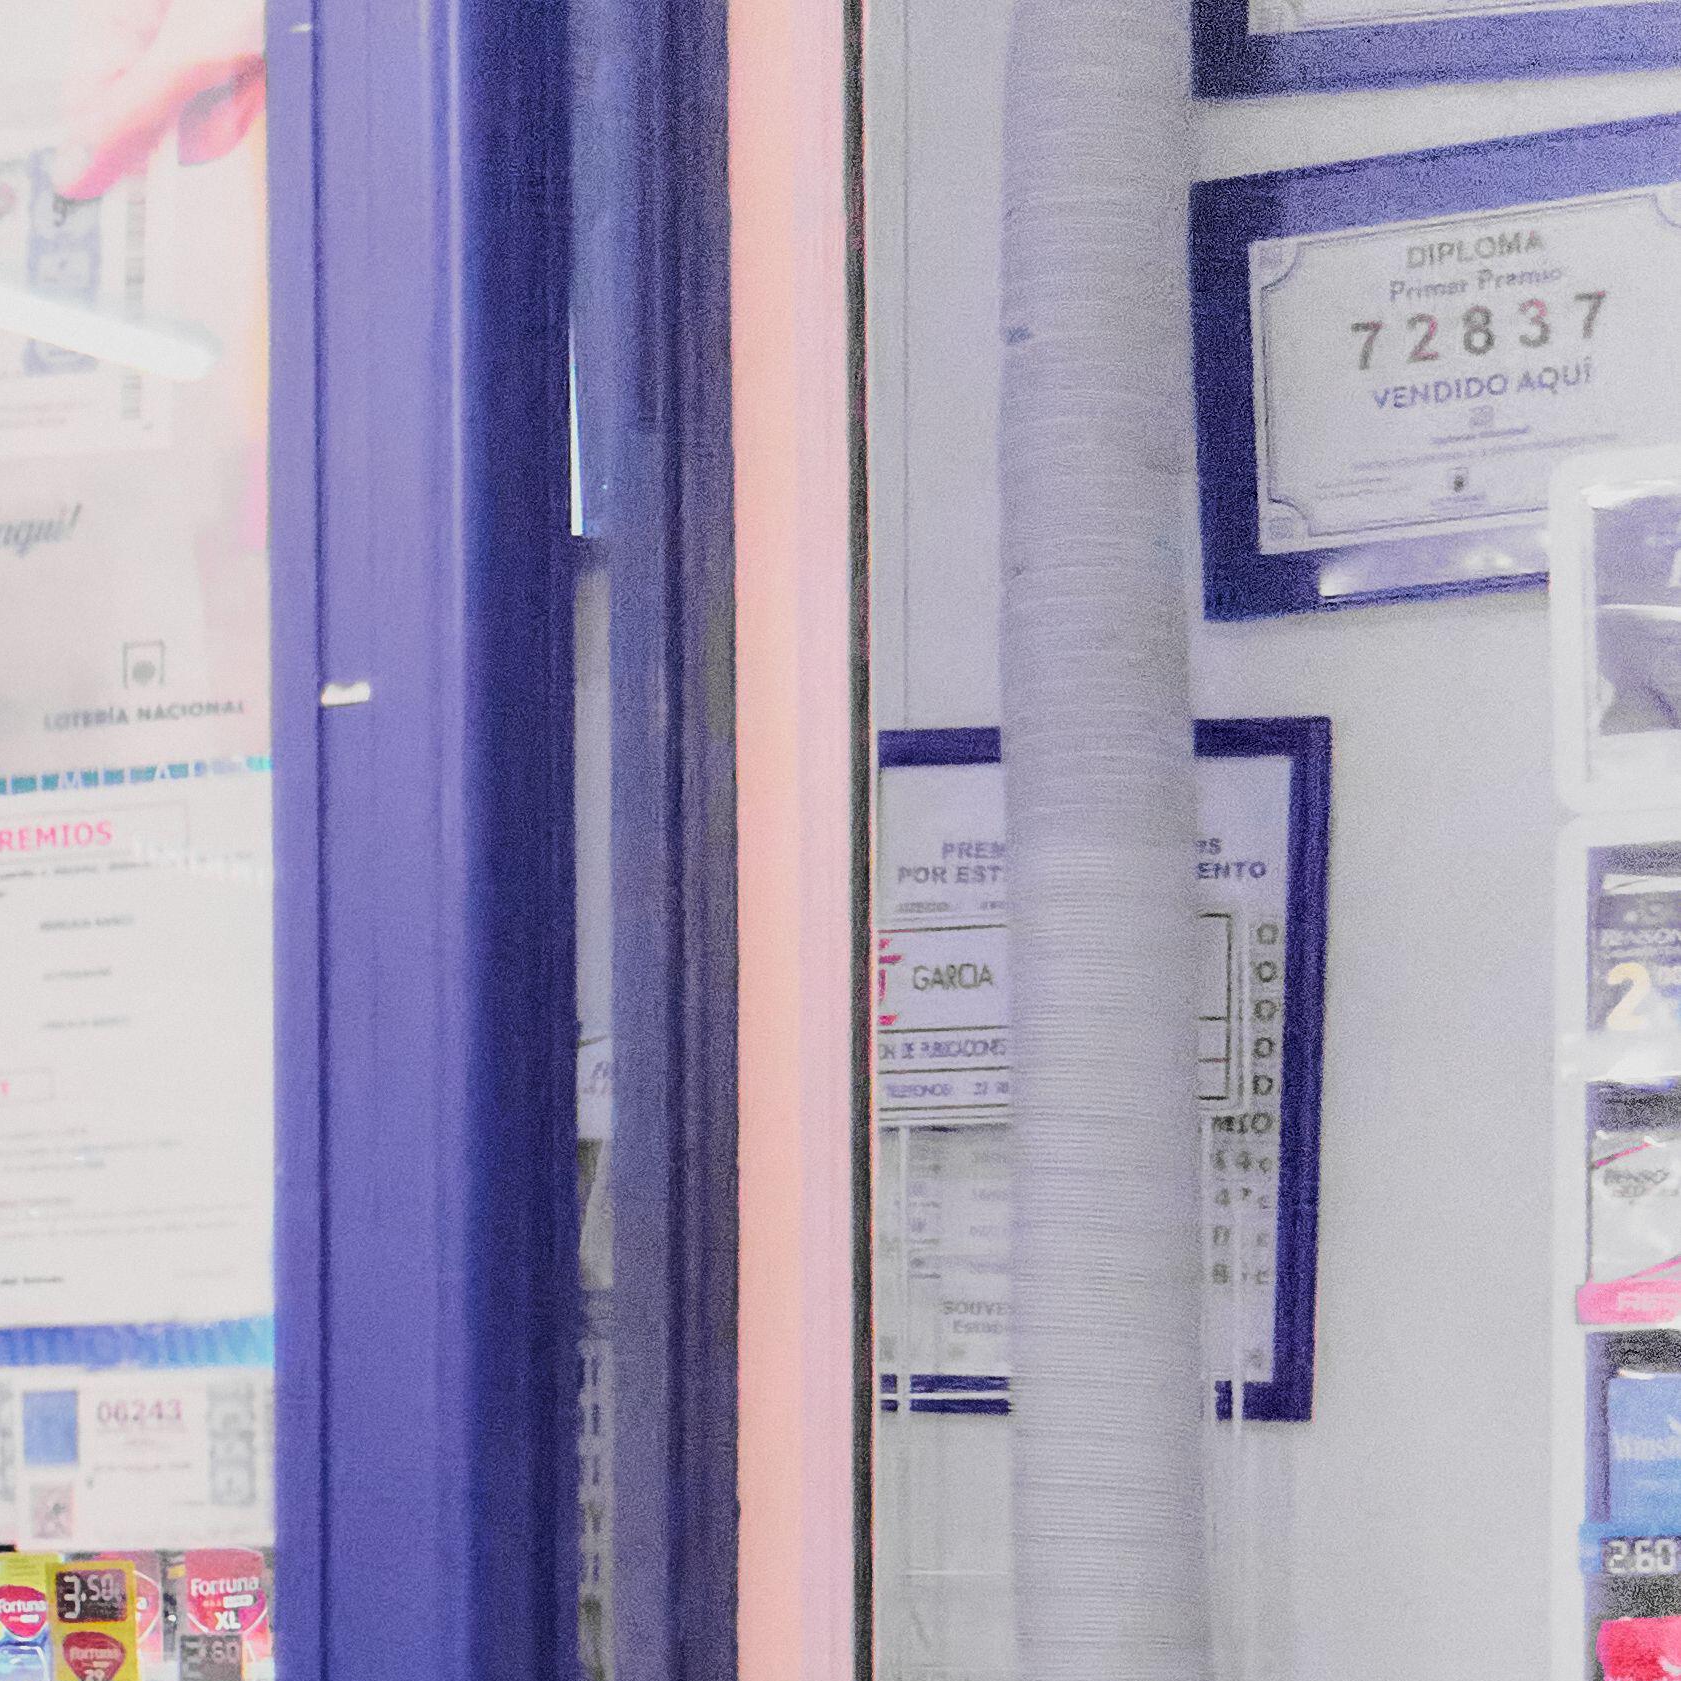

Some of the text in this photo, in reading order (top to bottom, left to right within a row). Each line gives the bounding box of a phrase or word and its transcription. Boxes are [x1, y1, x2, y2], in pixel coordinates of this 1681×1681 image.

[1407, 230, 1543, 269] DIPLOMA
[1373, 373, 1509, 408] VENDIDO
[137, 700, 244, 722] NACIONAL
[190, 1576, 260, 1597] Fortuna
[214, 1612, 241, 1631] XL
